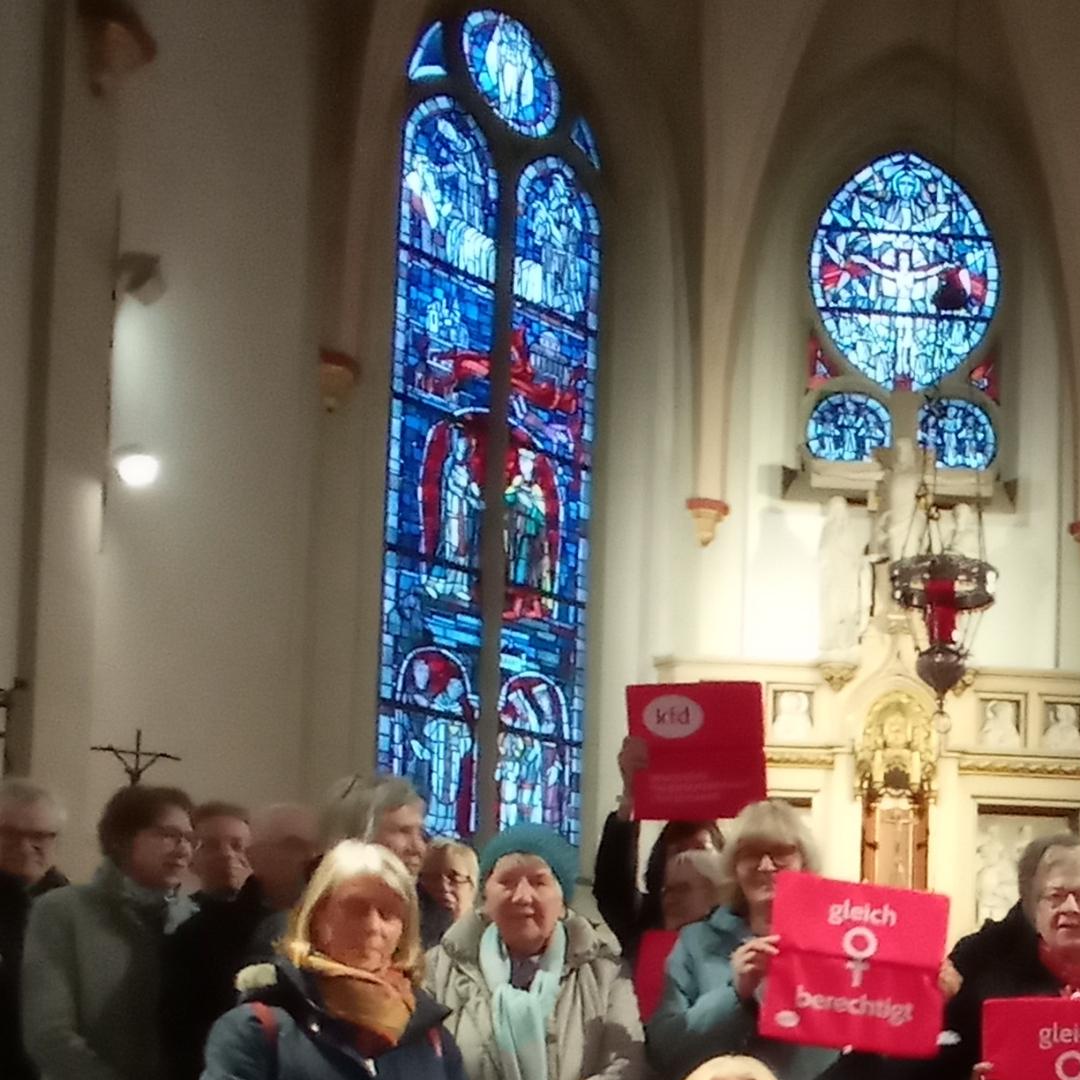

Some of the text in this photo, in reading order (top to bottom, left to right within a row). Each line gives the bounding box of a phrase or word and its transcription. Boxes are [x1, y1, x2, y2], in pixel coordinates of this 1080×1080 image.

[655, 706, 690, 725] kfd
[828, 899, 897, 927] gleich
[796, 984, 914, 1027] berechtigt
